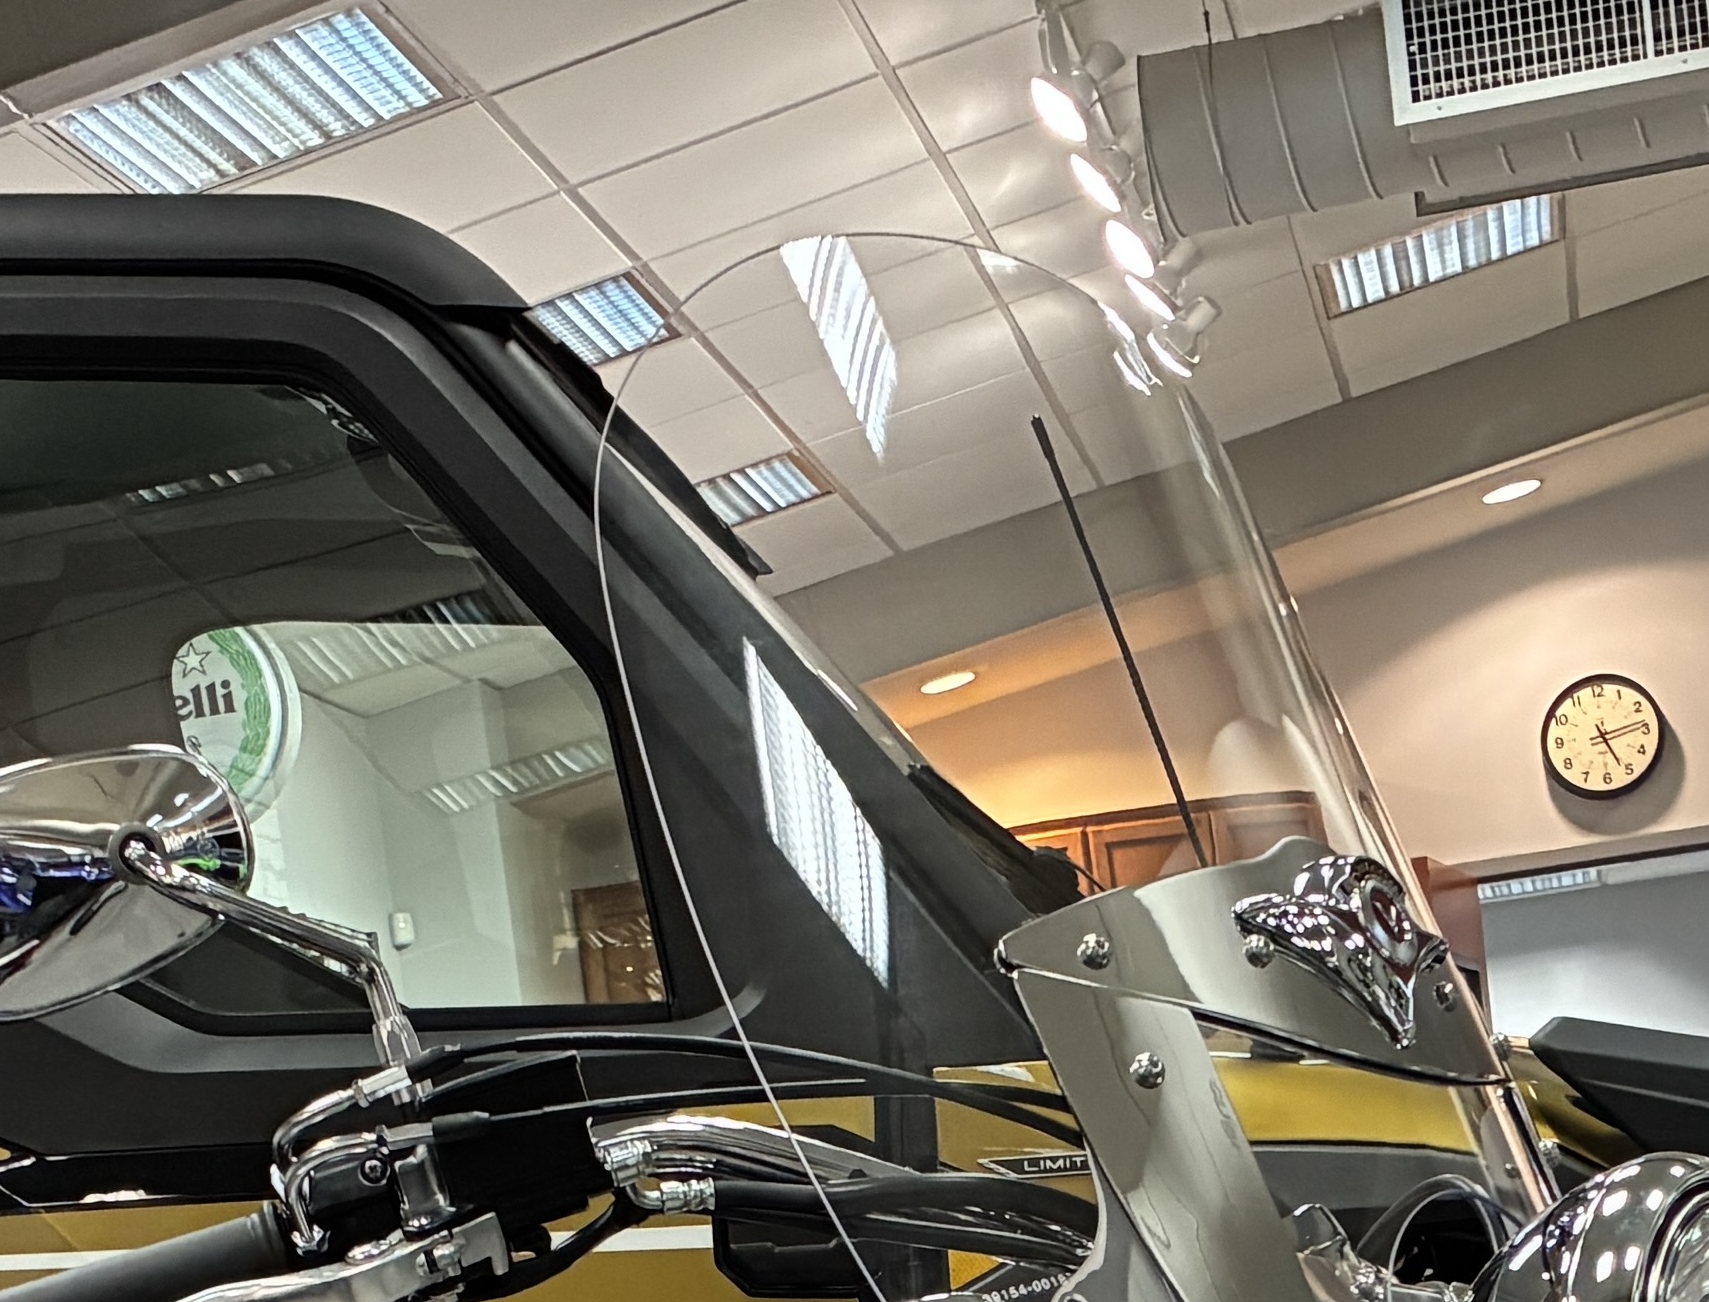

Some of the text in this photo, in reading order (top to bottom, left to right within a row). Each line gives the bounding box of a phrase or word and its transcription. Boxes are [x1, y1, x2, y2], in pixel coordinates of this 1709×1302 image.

[1591, 683, 1604, 698] 12
[1617, 689, 1622, 700] 1
[174, 679, 237, 722] elli
[1633, 701, 1643, 713] 2
[1554, 713, 1568, 726] 10
[1641, 723, 1651, 735] 3
[1555, 737, 1564, 749] 9
[1637, 744, 1646, 755] 4
[1563, 757, 1573, 770] 8
[1624, 763, 1634, 775] 5
[1581, 771, 1590, 784] 7
[1603, 772, 1613, 784] 6
[1024, 1157, 1087, 1172] LIMIT
